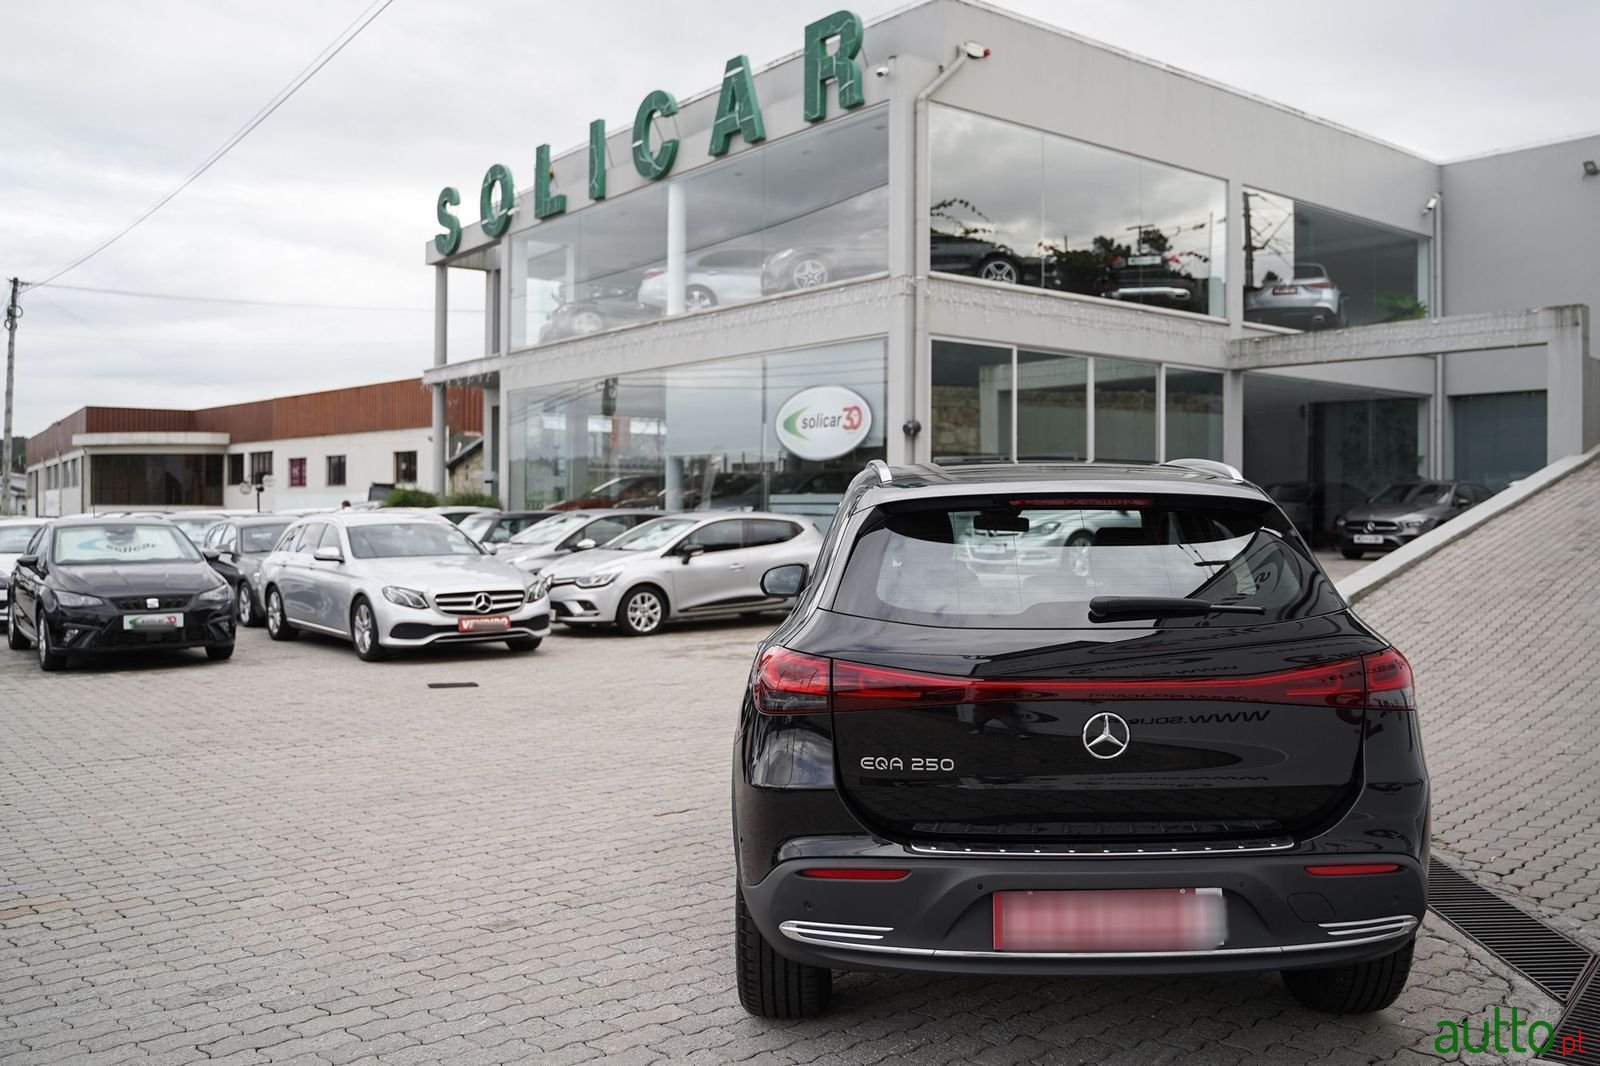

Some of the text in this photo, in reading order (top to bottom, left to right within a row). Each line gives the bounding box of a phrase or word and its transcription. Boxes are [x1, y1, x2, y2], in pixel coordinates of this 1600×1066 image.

[435, 10, 865, 256] SOLICAR
[801, 405, 863, 430] solicar 30
[860, 756, 955, 772] EQA 250
